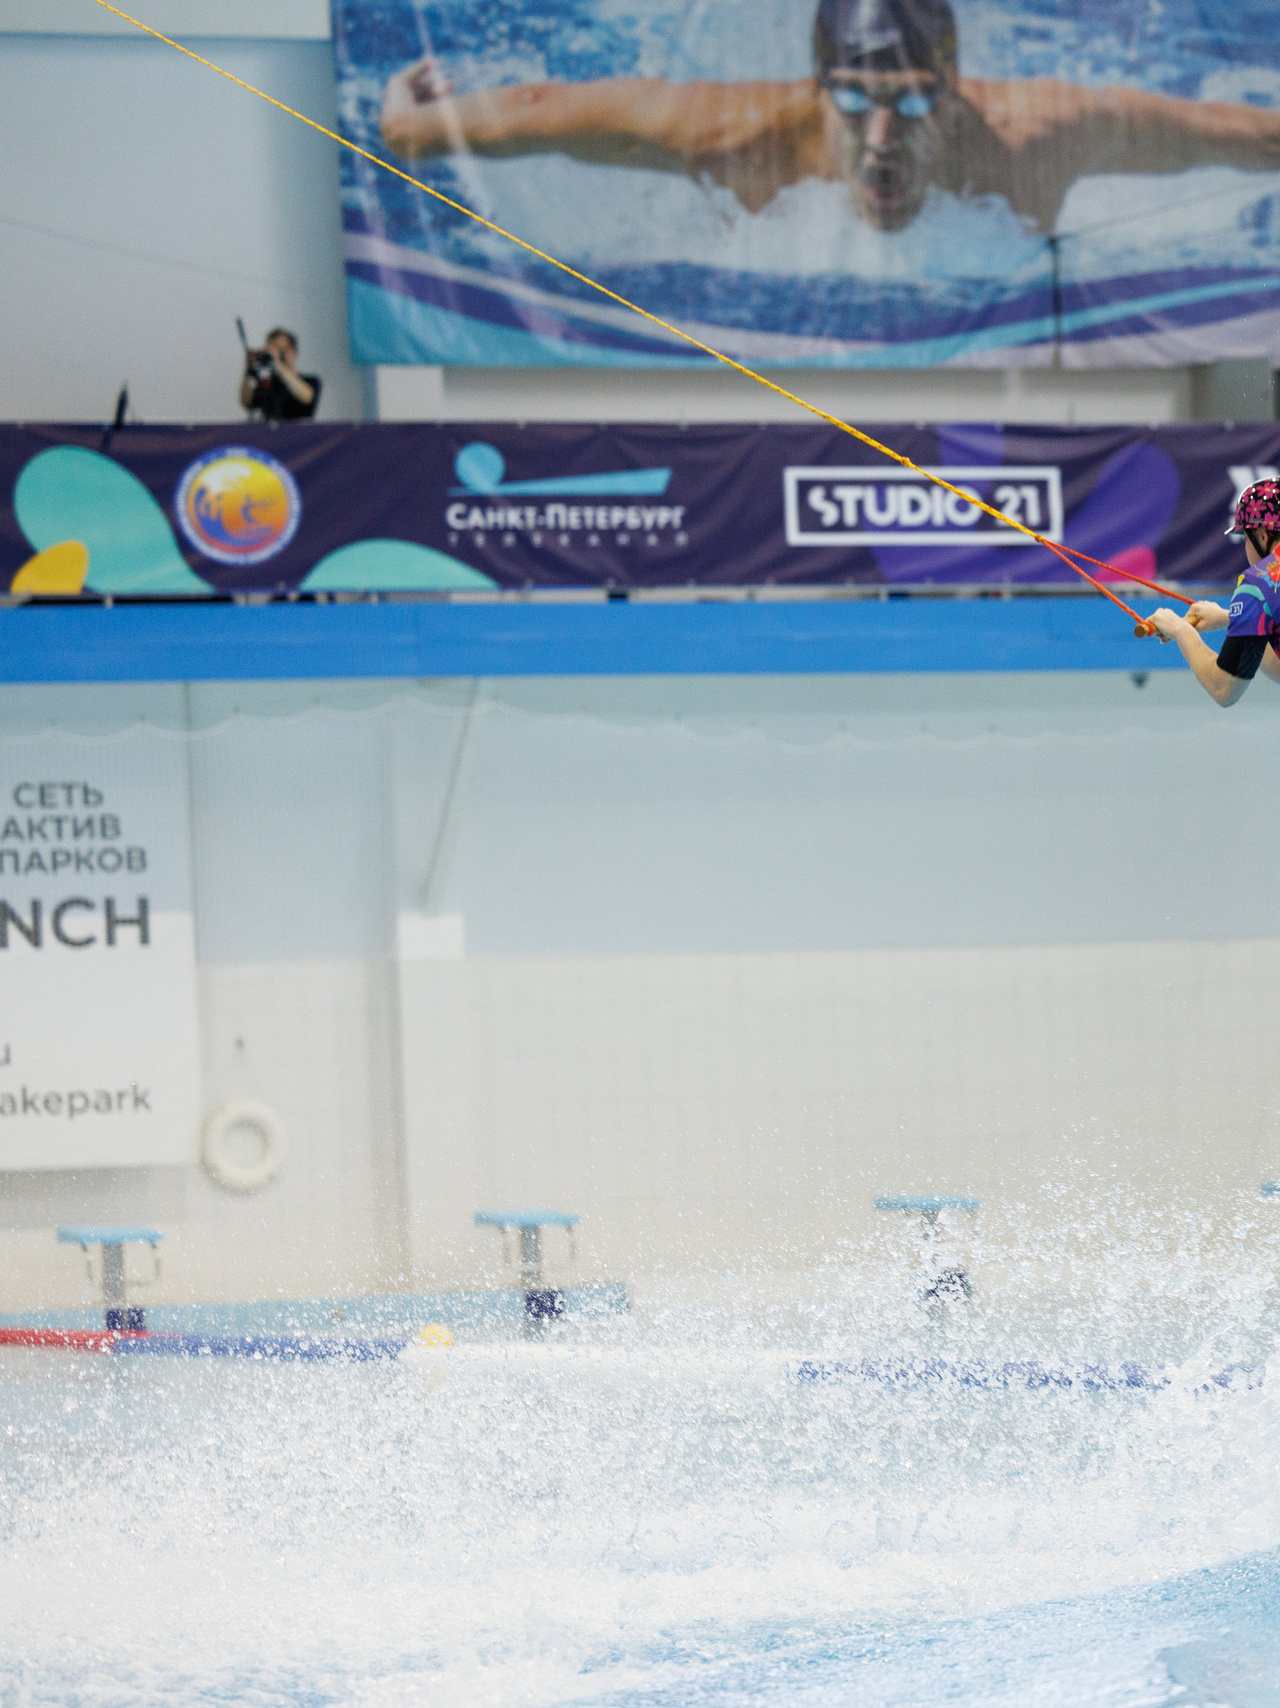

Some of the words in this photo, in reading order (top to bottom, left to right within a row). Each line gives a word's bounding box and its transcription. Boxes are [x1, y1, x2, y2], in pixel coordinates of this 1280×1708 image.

[807, 484, 983, 527] STUDIO
[993, 484, 1041, 527] 21
[13, 781, 104, 809] СЕТЬ
[0, 813, 121, 842] АКТИВ
[0, 844, 148, 875] ПАРКОВ
[0, 893, 150, 949] NCH
[0, 1081, 152, 1121] akepark
